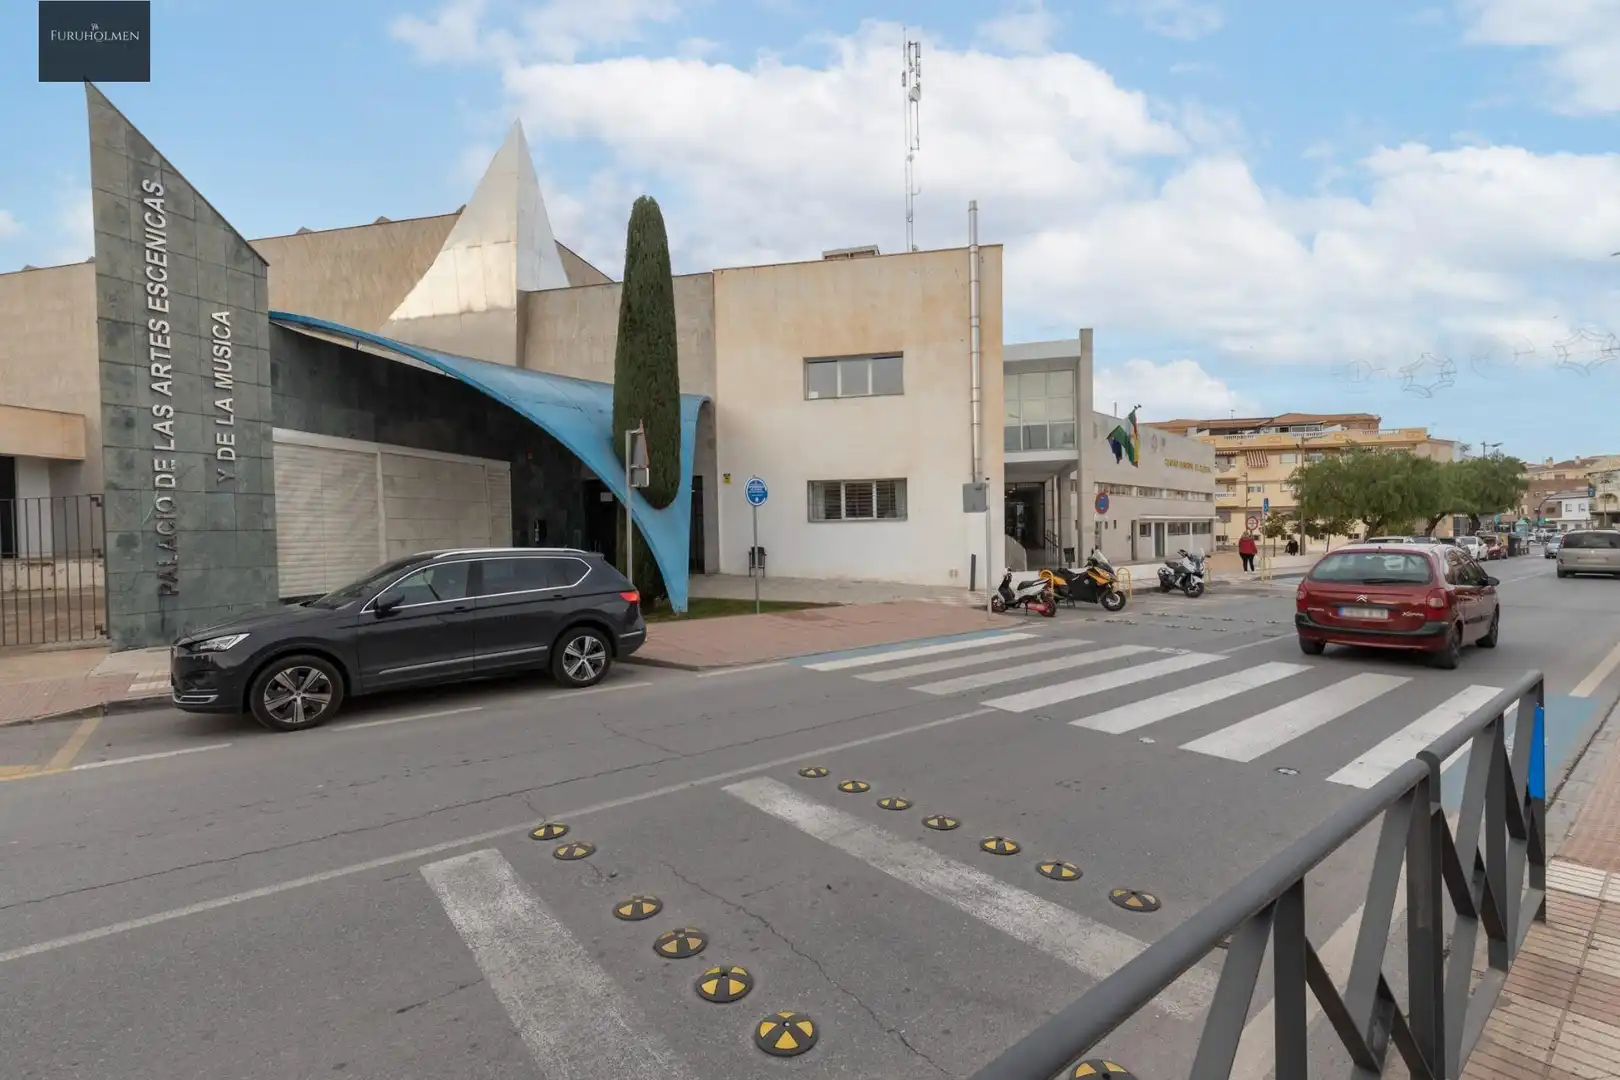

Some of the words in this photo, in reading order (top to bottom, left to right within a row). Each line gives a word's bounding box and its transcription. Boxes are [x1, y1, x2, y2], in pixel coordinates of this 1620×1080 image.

[142, 179, 169, 313] ESCENICAS
[148, 318, 172, 397] ARTES
[211, 311, 233, 390] MUSICA
[152, 404, 175, 451] LAS
[214, 397, 234, 426] LA
[216, 432, 236, 461] DE
[154, 458, 176, 489] DE
[217, 468, 236, 484] Y
[156, 496, 179, 596] PALACIO
